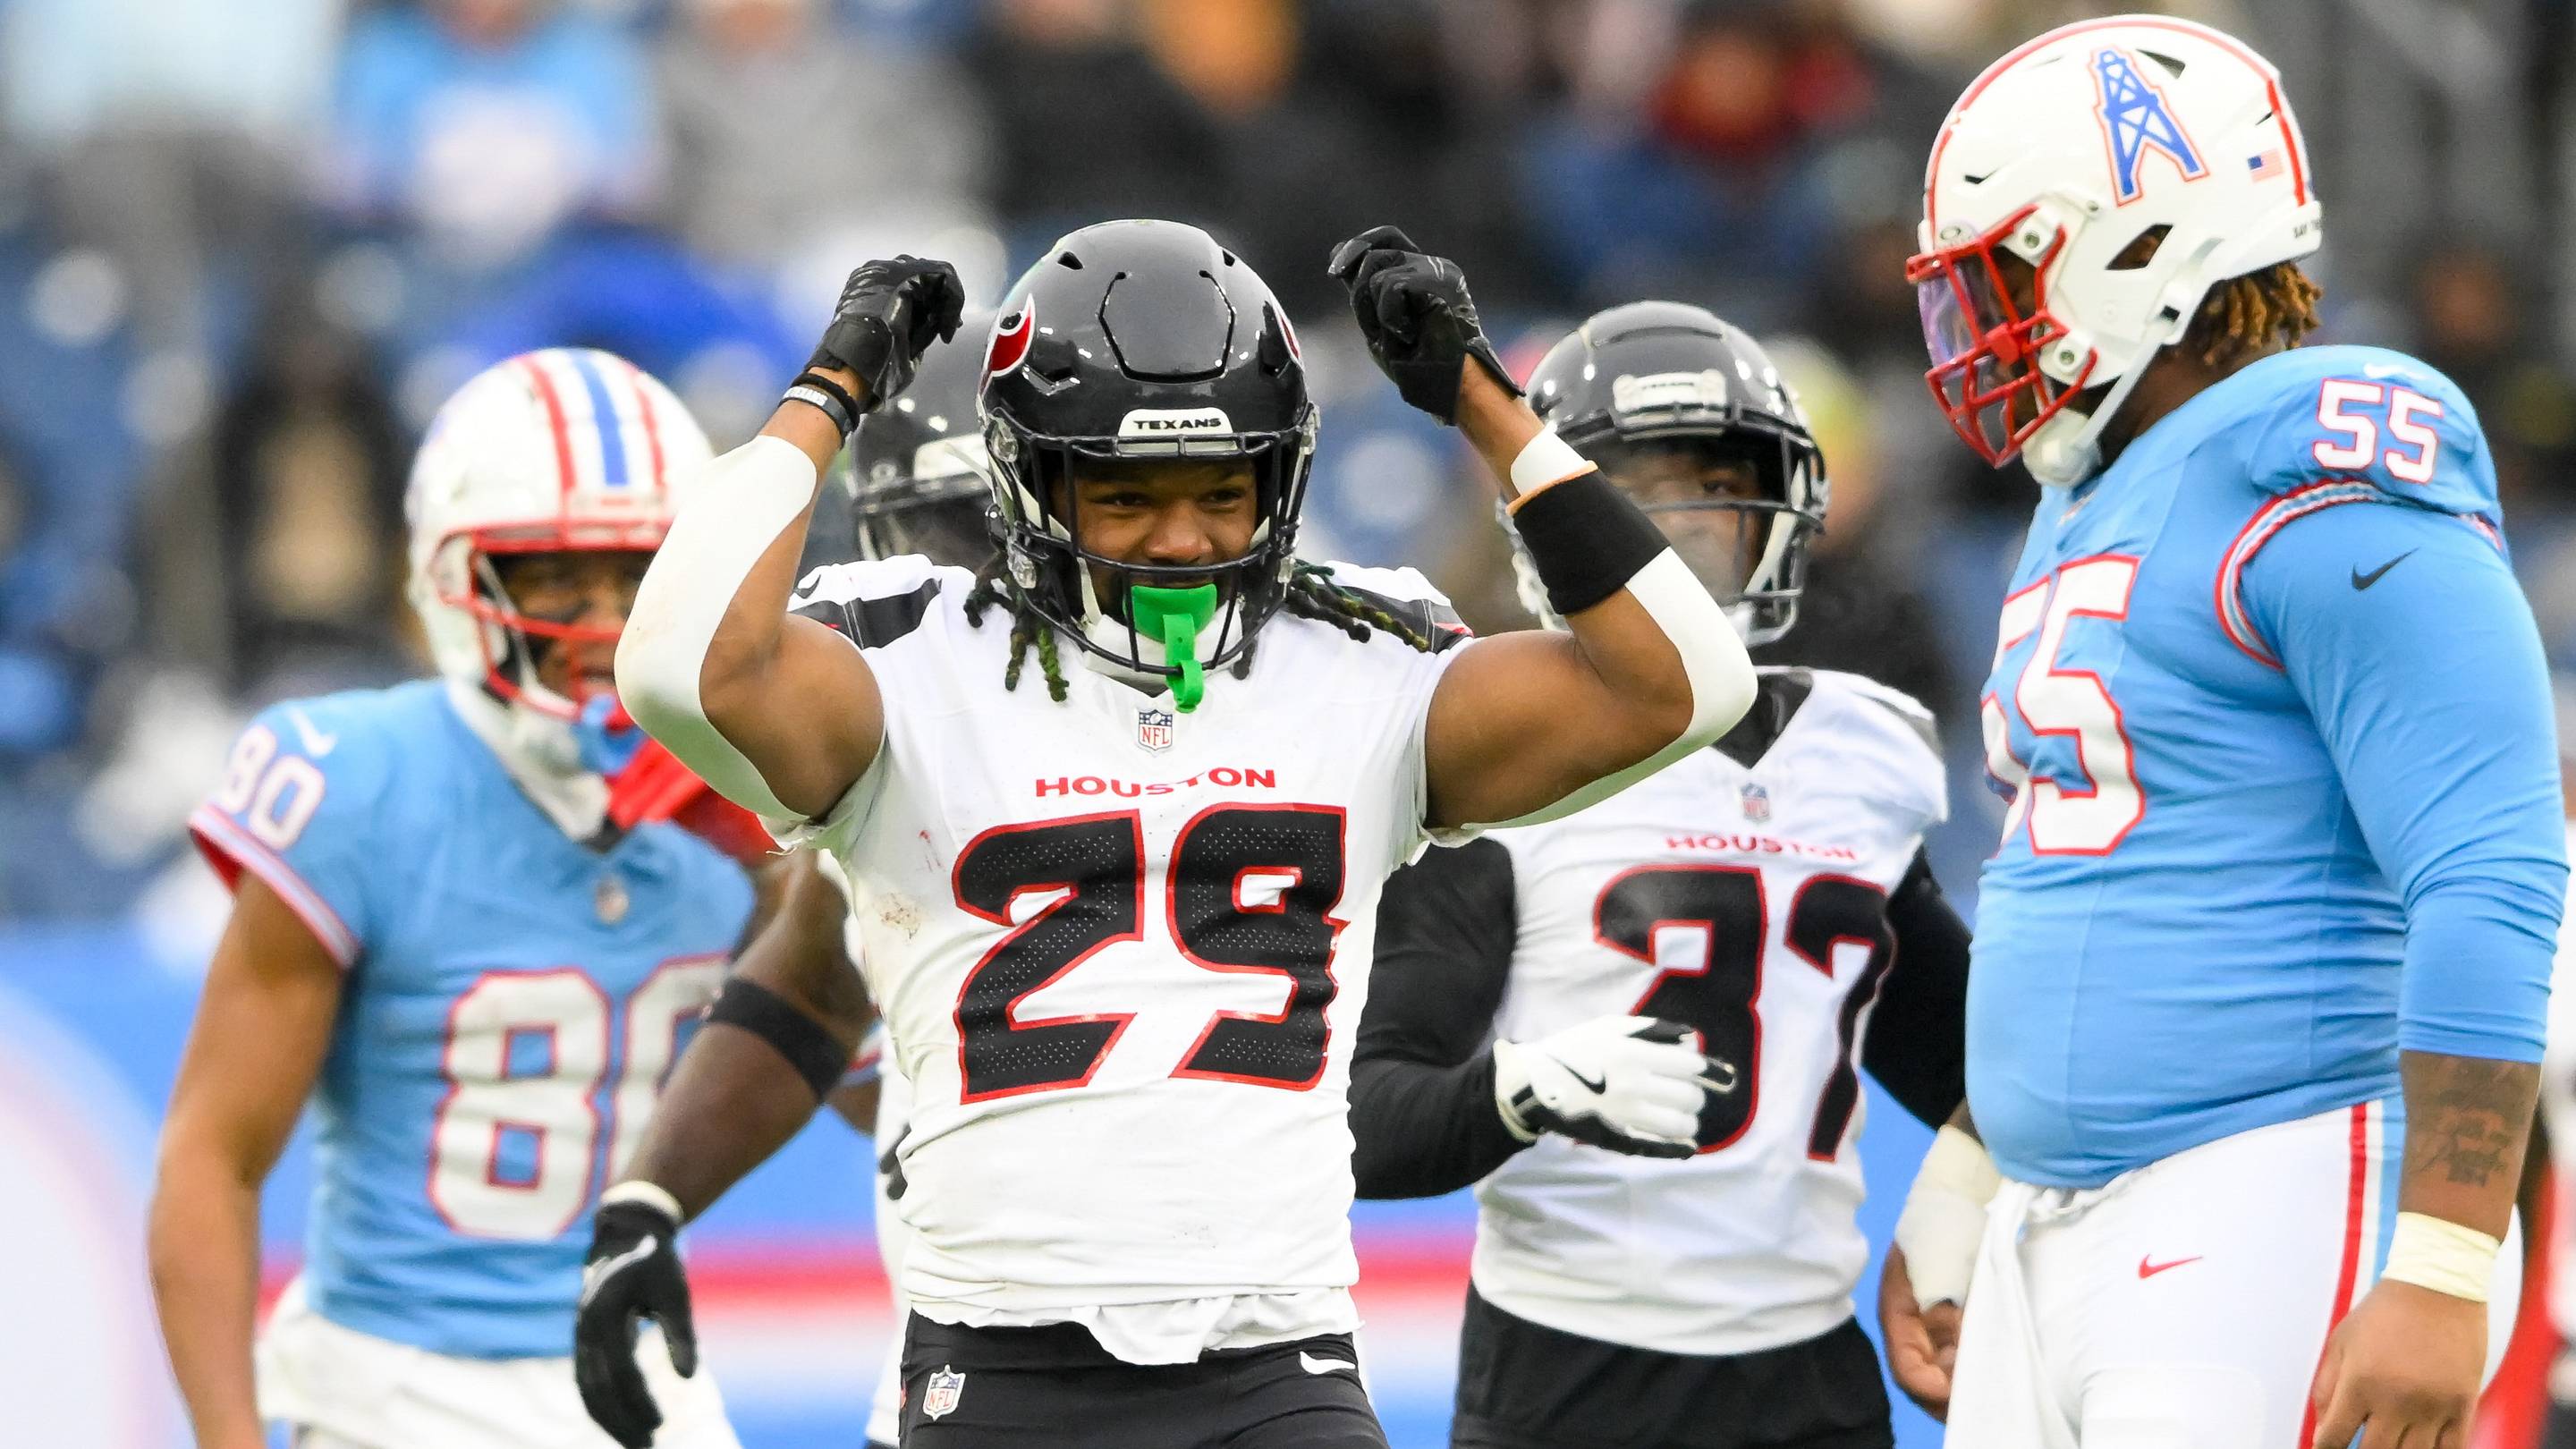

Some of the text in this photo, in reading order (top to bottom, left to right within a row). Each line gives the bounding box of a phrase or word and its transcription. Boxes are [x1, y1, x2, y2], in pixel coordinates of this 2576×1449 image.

[1132, 418, 1222, 430] TEXANS
[2312, 377, 2445, 486] 55
[221, 724, 326, 850] 80
[1036, 767, 1276, 798] HOUSTON
[1141, 725, 1170, 746] NFL
[951, 801, 1352, 1106] 29
[1592, 862, 1899, 1164] 37
